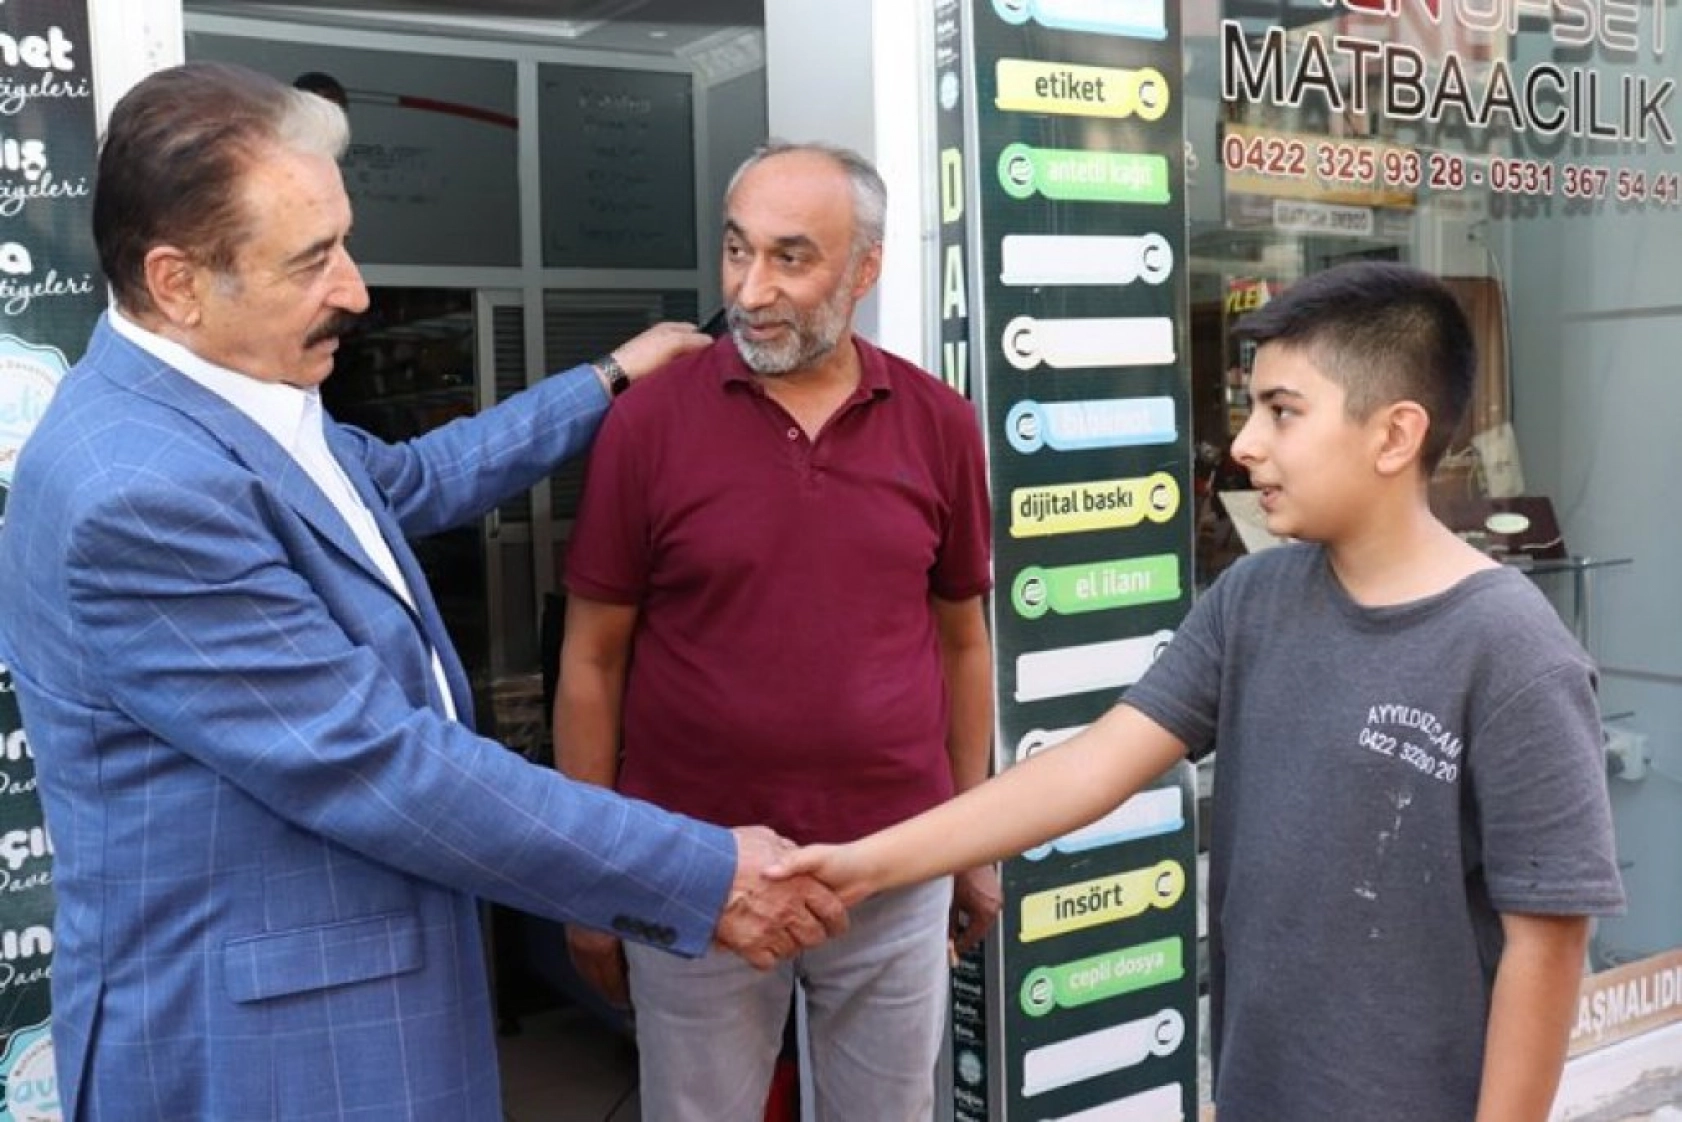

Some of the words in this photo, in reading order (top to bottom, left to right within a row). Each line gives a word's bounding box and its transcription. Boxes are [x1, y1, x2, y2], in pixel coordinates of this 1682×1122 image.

[1034, 73, 1105, 102] etiket
[1221, 20, 1676, 144] MATBAACILIK
[1223, 135, 1306, 176] 0422
[1317, 140, 1373, 181] 325
[1384, 149, 1420, 185] 93
[1430, 155, 1464, 188] 28
[1491, 160, 1553, 194] 0531
[1563, 166, 1607, 197] 367
[1617, 169, 1645, 200] 54
[1651, 173, 1679, 202] 41
[1020, 490, 1077, 522] dijital
[1083, 486, 1134, 511] baskı
[1075, 571, 1098, 599] el
[1103, 568, 1151, 596] ilanı
[1359, 727, 1397, 756] 0422
[1434, 761, 1458, 783] 20
[1054, 885, 1124, 921] insört
[1114, 951, 1164, 977] dosya
[1570, 965, 1682, 1040] AŞMALIDI
